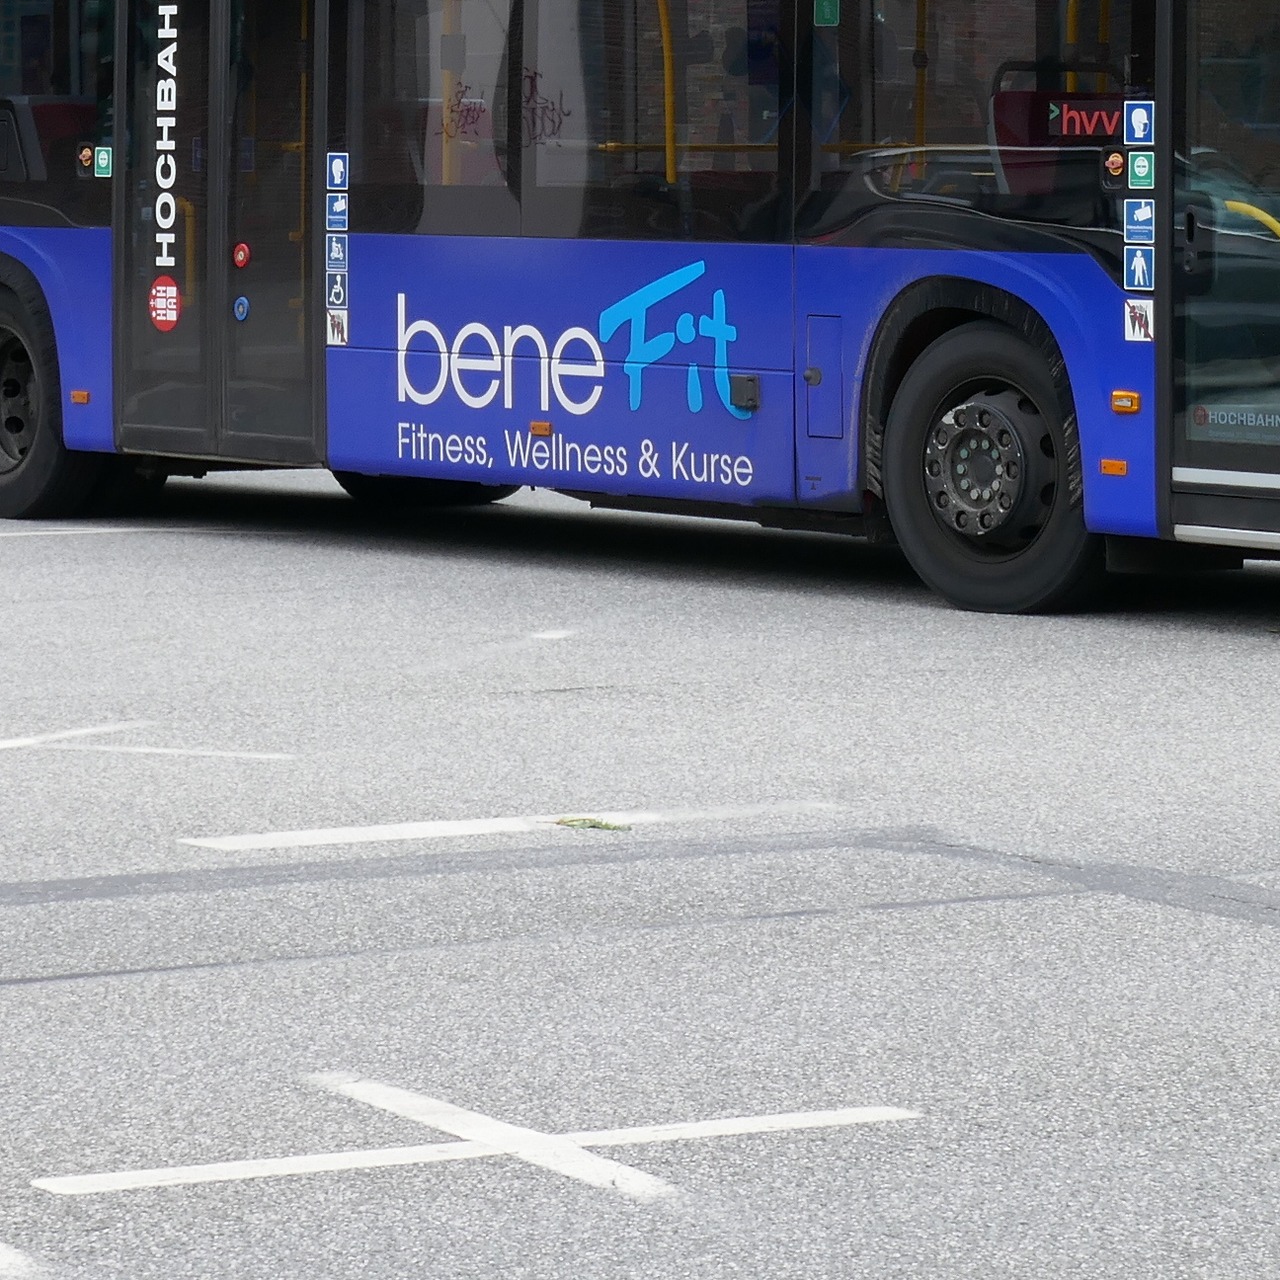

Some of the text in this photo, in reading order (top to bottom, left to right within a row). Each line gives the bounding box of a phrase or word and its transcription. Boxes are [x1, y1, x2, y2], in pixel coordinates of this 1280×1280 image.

[397, 421, 754, 486] Fitness, Wellness & Kurse
